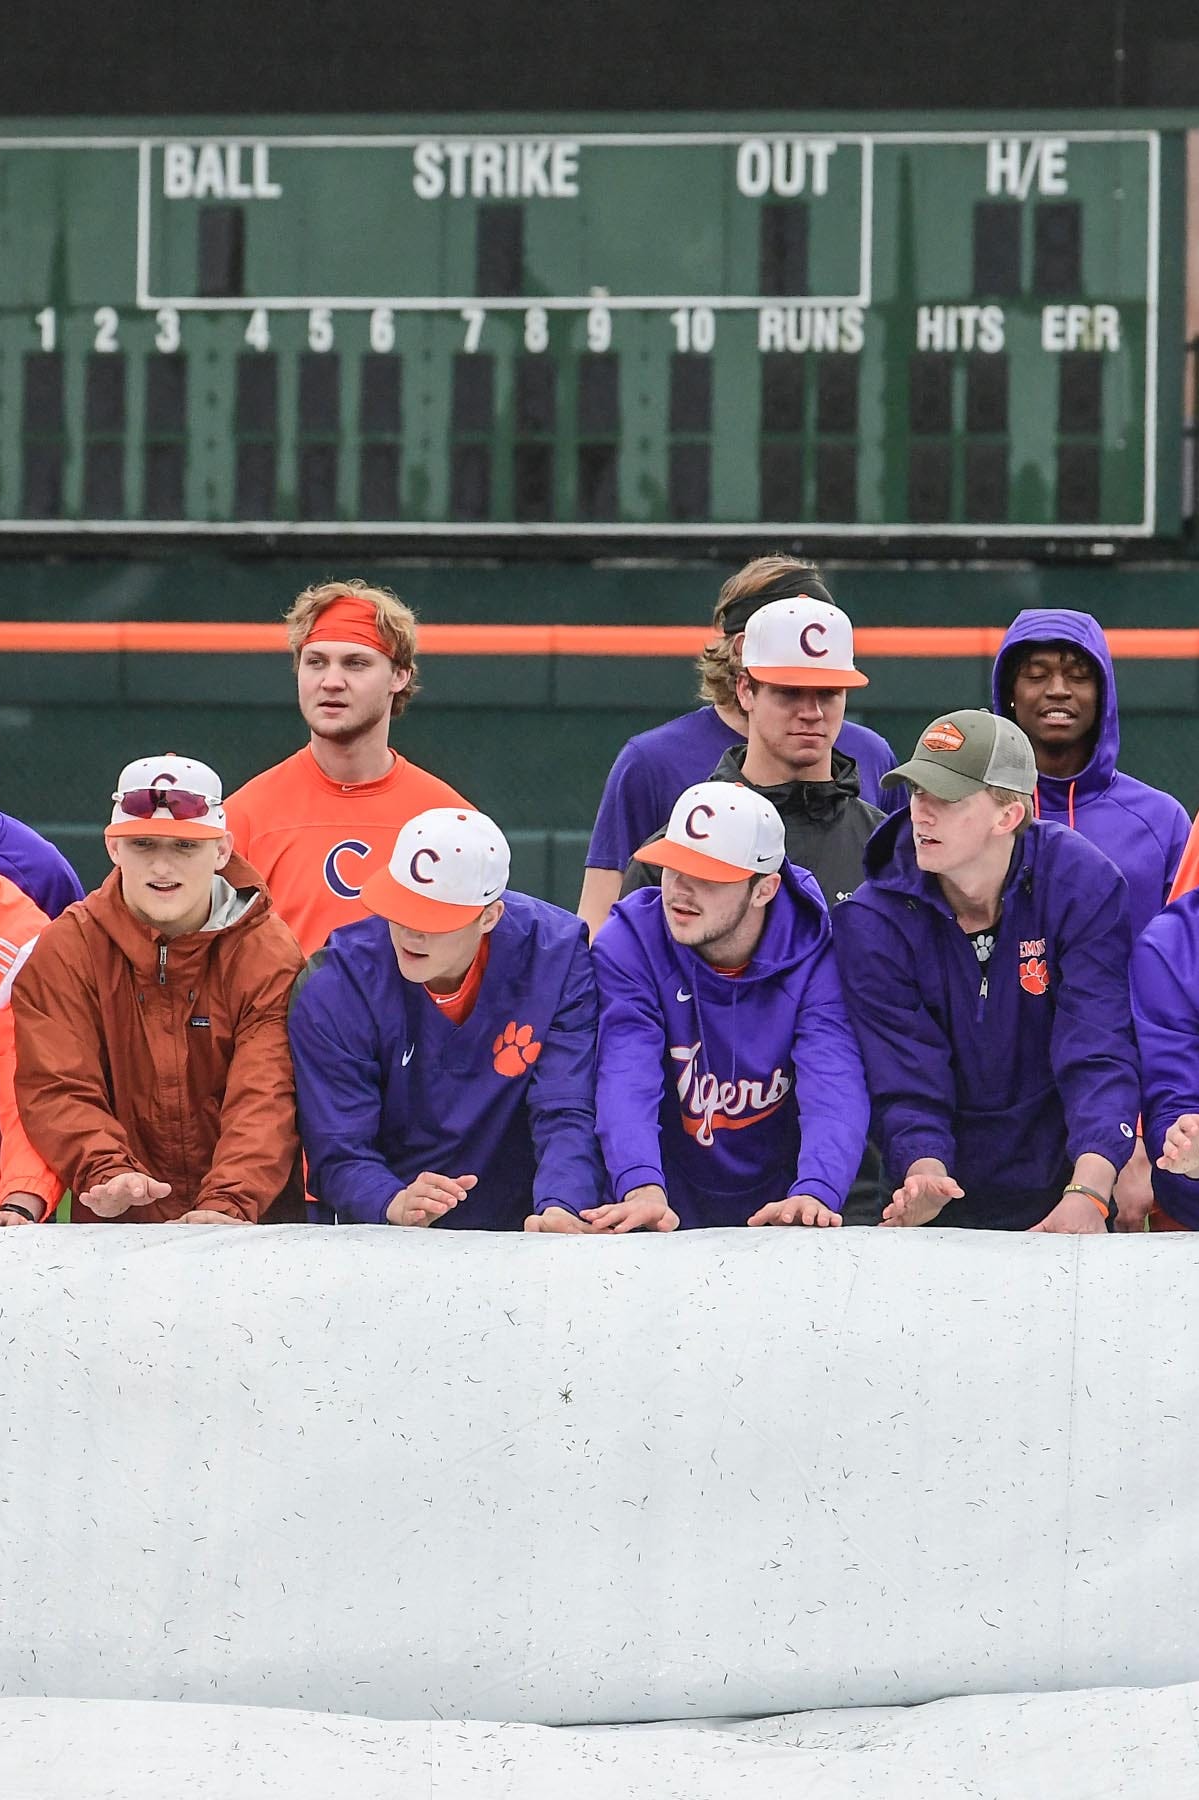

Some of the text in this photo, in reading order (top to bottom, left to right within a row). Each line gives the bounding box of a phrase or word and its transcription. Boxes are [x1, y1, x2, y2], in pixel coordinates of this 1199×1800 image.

[163, 144, 281, 198] BALL
[414, 141, 580, 199] STRIKE
[736, 141, 836, 197] OUT
[986, 139, 1068, 200] H/E
[36, 306, 1121, 353] 1 2 3 4 5 6 7 8 9 10 RUNS HITS ERR
[799, 623, 829, 658] C
[685, 804, 715, 840] C
[323, 839, 372, 899] C
[410, 848, 440, 884] C
[669, 1040, 792, 1147] Tigers
